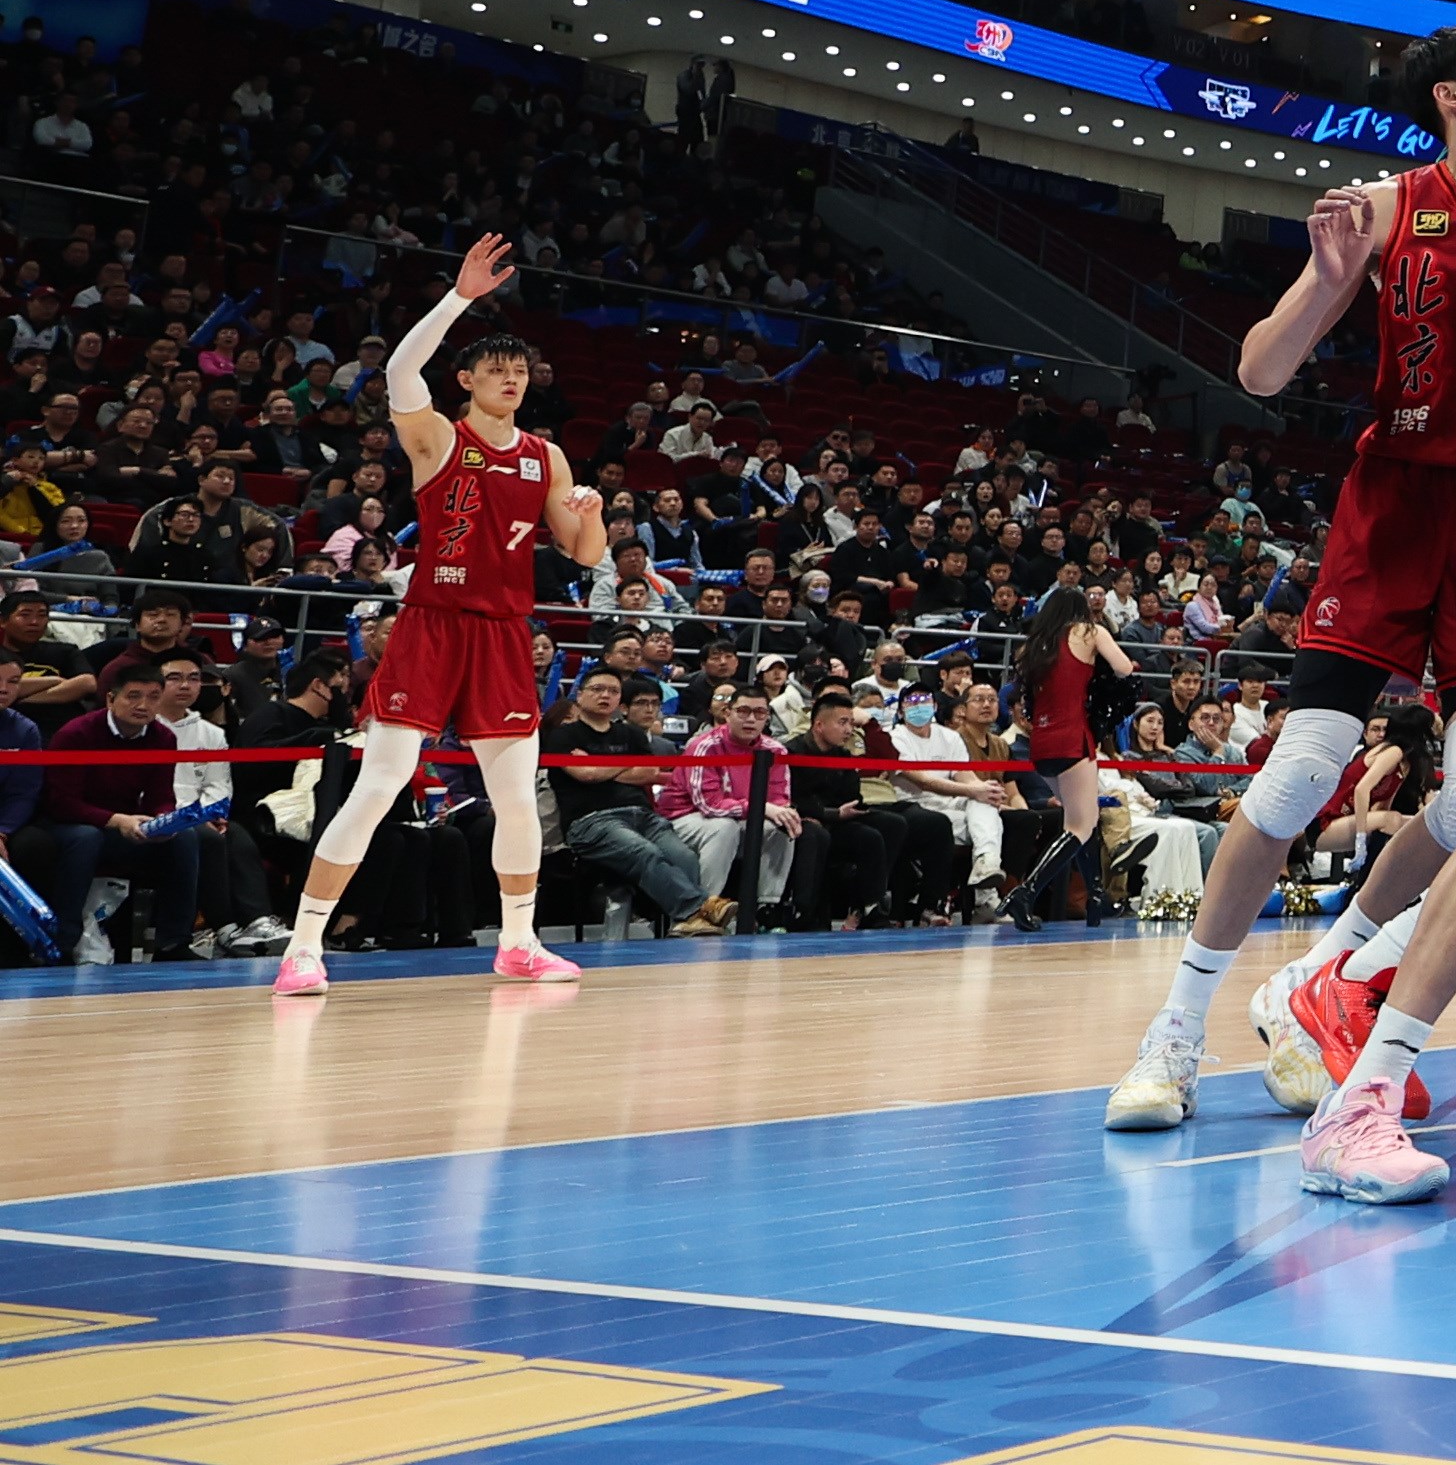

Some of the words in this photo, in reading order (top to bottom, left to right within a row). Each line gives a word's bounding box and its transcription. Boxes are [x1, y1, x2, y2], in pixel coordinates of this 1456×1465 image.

[1311, 102, 1395, 145] LET'S
[1391, 251, 1446, 394] 北京
[506, 519, 535, 552] 7
[433, 565, 467, 577] 1956
